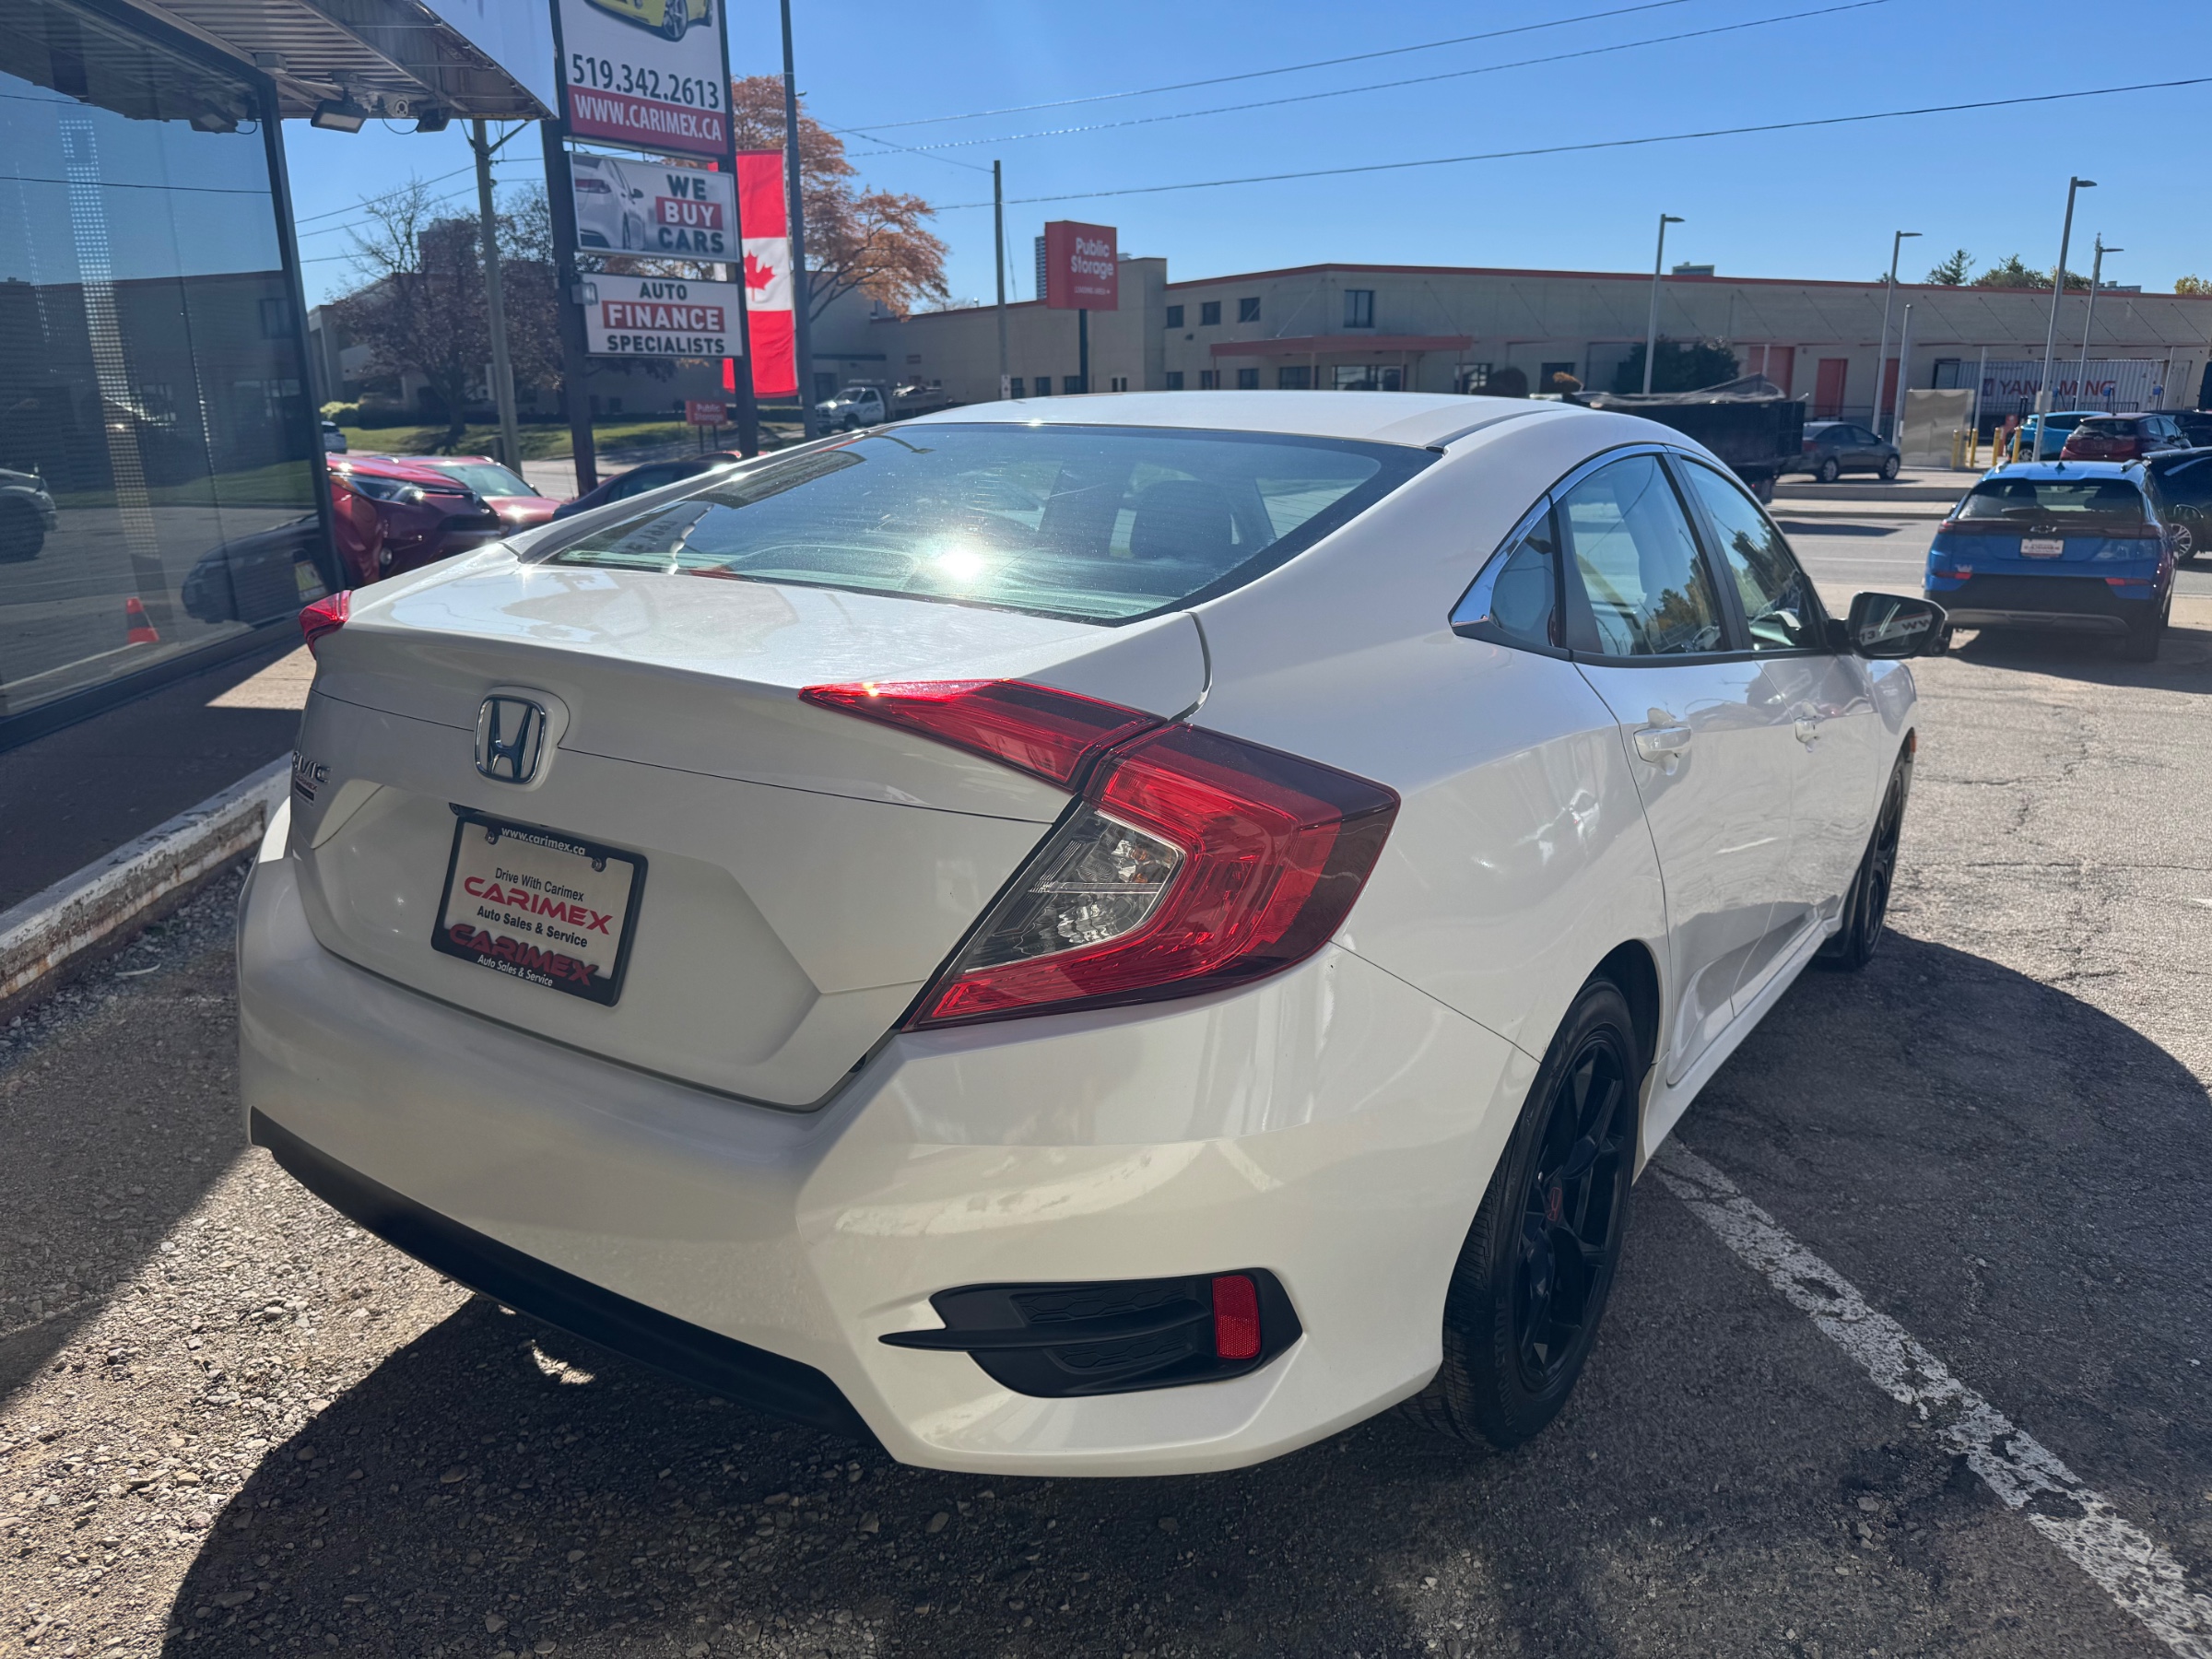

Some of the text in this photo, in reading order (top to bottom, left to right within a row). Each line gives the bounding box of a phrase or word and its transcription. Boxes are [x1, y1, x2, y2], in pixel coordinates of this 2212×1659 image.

[572, 53, 720, 109] 519.342.2613
[573, 94, 723, 142] WWW.CARIMEX.CA
[667, 174, 707, 201] WE
[665, 204, 715, 228] BUY
[658, 227, 724, 253] CARS
[1076, 237, 1110, 257] Public
[1070, 255, 1114, 280] Storage
[639, 282, 688, 300] AUTO
[608, 305, 721, 331] FINANCE
[606, 335, 724, 354] SPECIALISTS
[1999, 380, 2116, 396] YAN MNG
[292, 750, 333, 783] CIVIC
[501, 827, 586, 856] www.carimex.ca
[495, 867, 584, 901] Drive With Carimex
[464, 876, 613, 935] CARIMEX
[477, 905, 588, 947] Auto Sales & Service
[448, 923, 599, 986] CARIMEX
[477, 954, 554, 987] Auto Sales & Service
